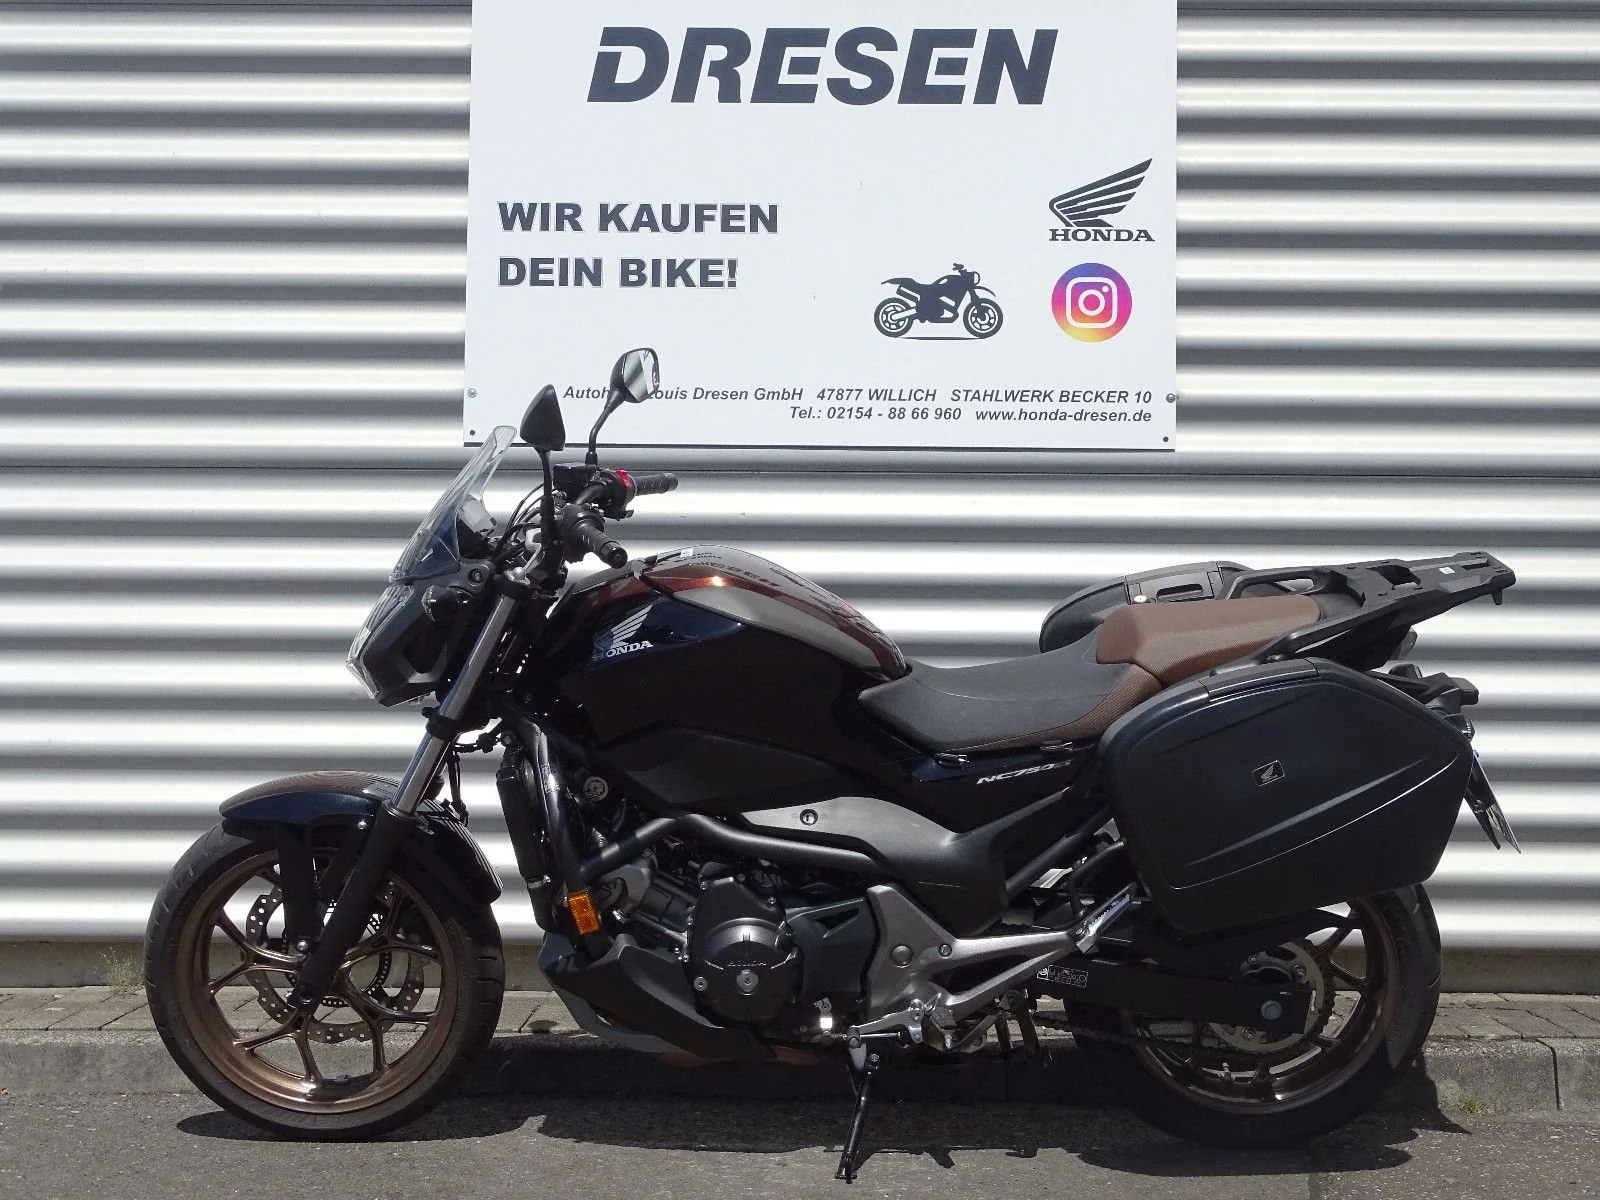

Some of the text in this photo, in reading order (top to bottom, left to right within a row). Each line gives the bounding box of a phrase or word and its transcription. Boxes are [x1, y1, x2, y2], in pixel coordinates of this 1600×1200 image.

[587, 27, 1058, 105] DRESEN
[498, 203, 778, 233] WIR KAUFEN
[1049, 228, 1155, 242] HONDA
[499, 258, 737, 288] DEIN BIKE!
[563, 386, 609, 400] Autoh
[693, 387, 748, 401] Dresen
[754, 387, 803, 401] GmbH
[817, 388, 863, 401] 47877
[869, 388, 937, 402] WILLICH
[951, 389, 1055, 403] STAHLWERK
[1059, 390, 1129, 403] BECKER
[1135, 391, 1152, 403] 10
[790, 406, 822, 419] Tel.:
[827, 406, 873, 420] 02154
[888, 407, 906, 420] 88
[912, 407, 929, 420] 66
[934, 407, 962, 420] 960
[975, 407, 1152, 422] www.honda-dresen.de
